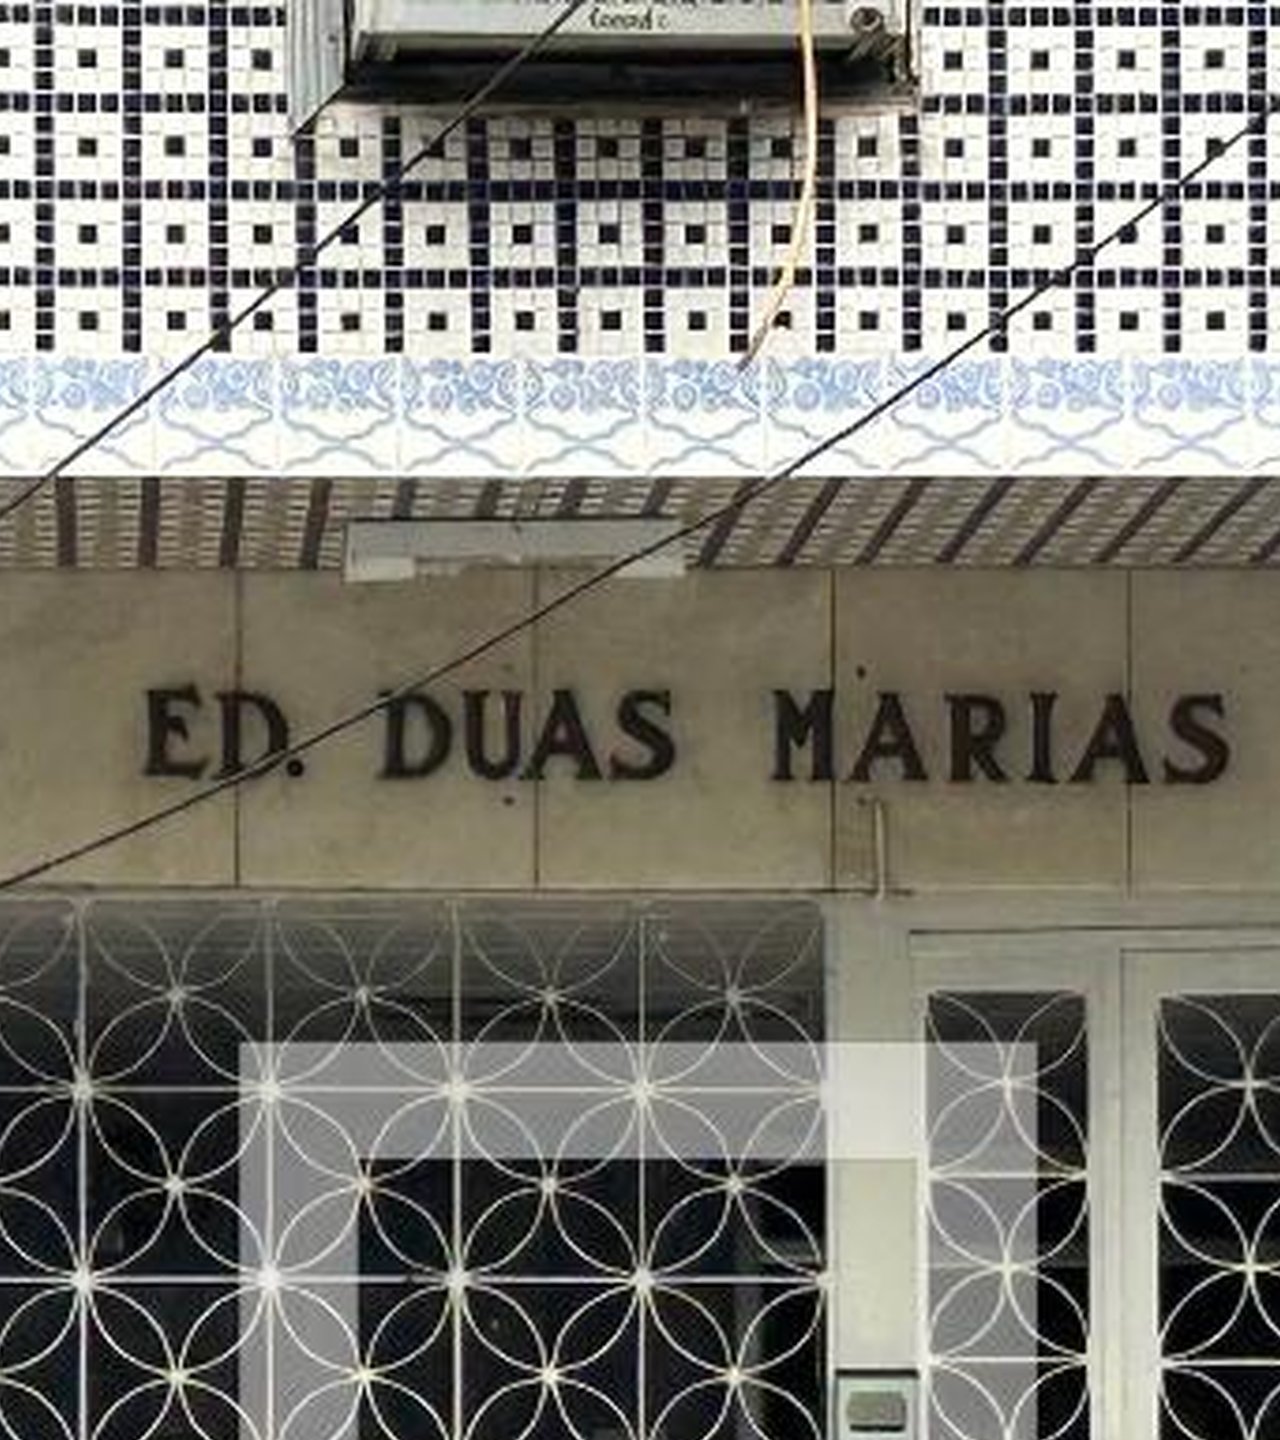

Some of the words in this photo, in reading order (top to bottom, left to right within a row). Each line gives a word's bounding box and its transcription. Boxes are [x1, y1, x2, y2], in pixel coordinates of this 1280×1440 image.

[143, 684, 304, 781] ED.
[375, 687, 677, 781] DUAS
[770, 690, 1231, 784] MARIAS
